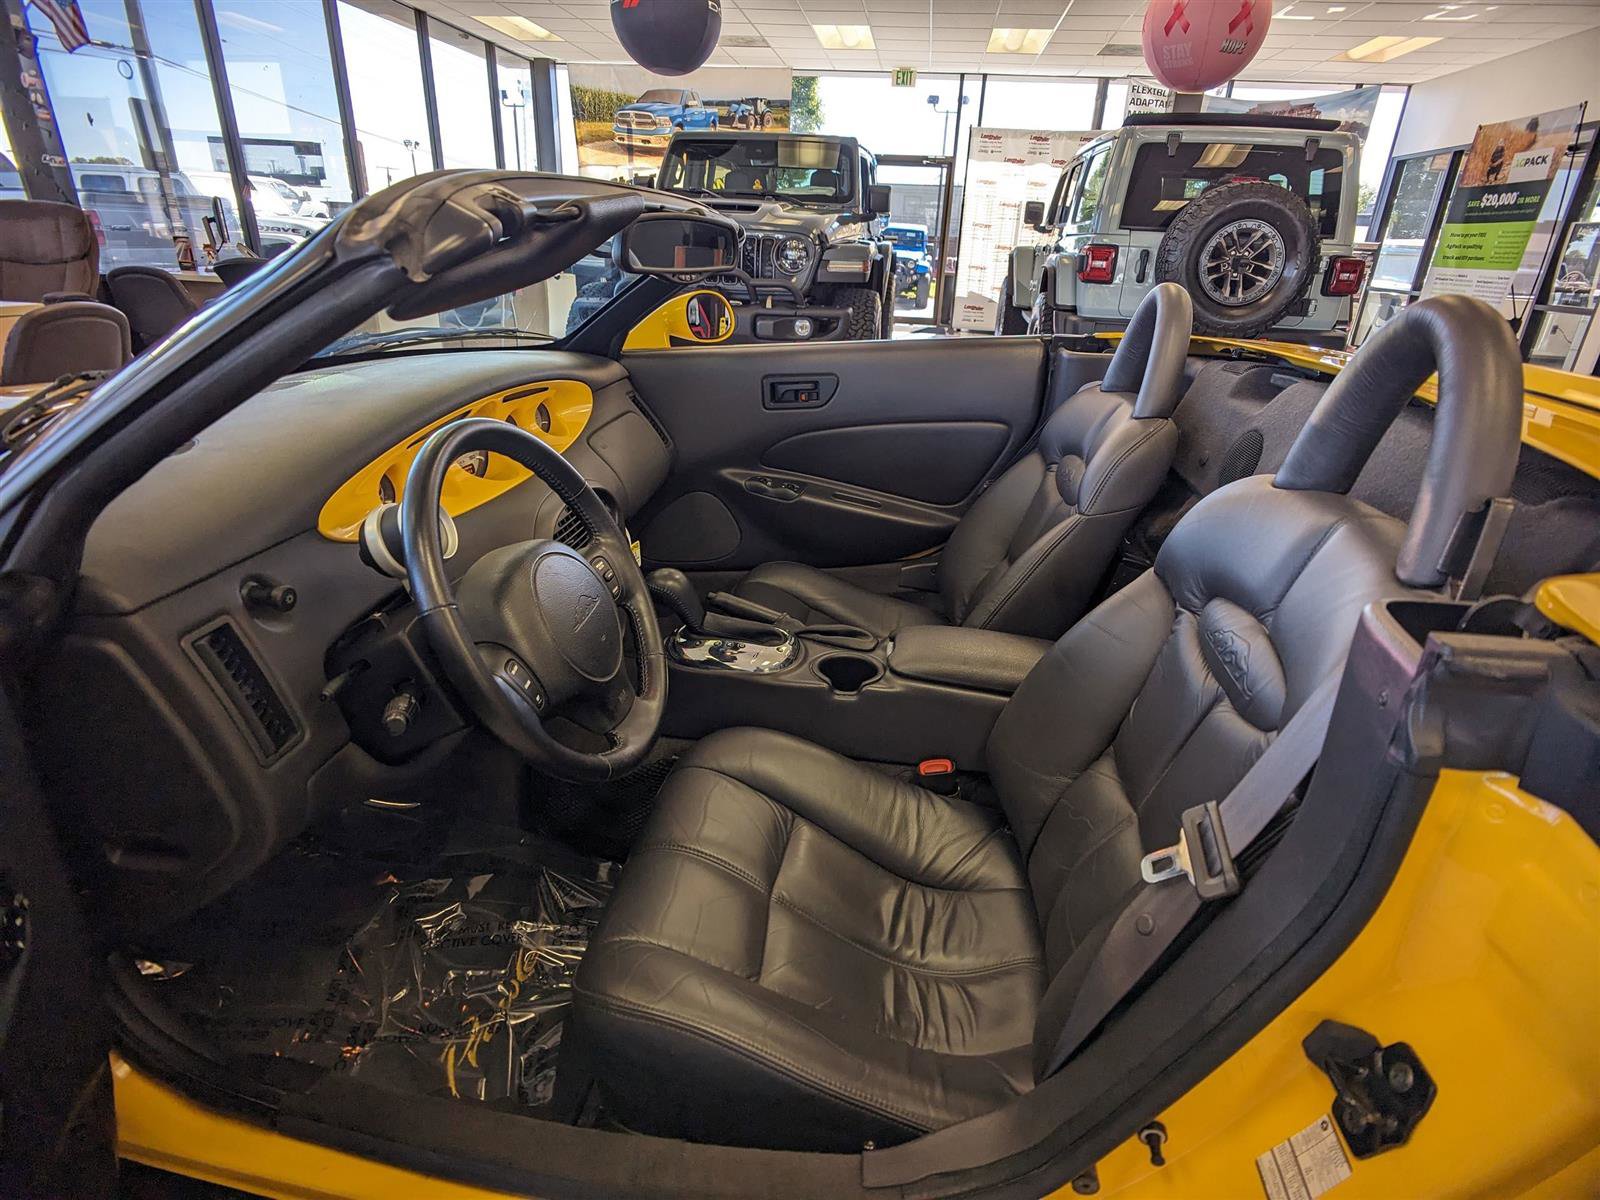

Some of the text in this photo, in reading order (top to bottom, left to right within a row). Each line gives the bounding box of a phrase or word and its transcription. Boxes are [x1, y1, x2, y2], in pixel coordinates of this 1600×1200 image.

[1162, 41, 1192, 59] STAY
[1219, 39, 1248, 54] HOPE
[896, 70, 913, 86] EXIT
[1131, 84, 1174, 98] FLEXIBL
